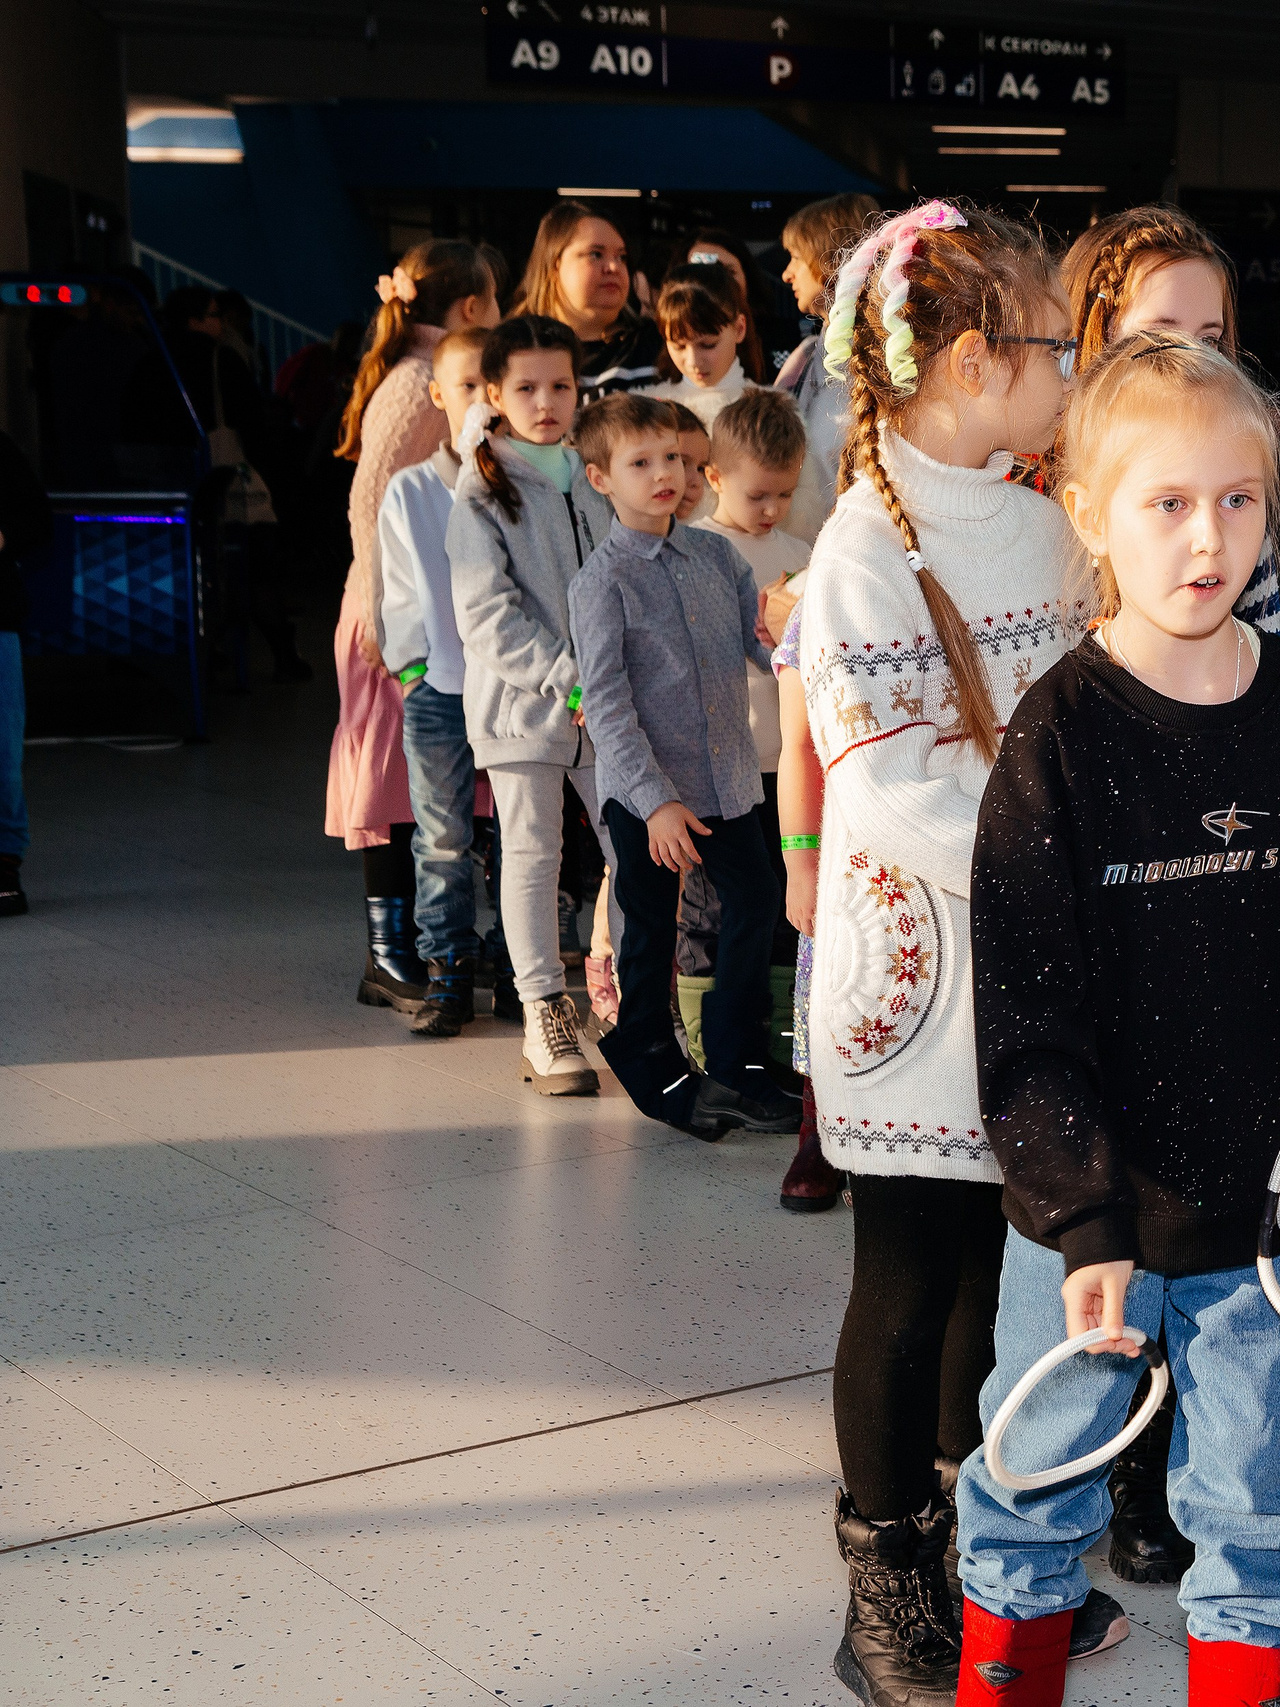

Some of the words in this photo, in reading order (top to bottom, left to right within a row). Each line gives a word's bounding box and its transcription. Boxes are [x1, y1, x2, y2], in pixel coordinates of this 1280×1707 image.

[597, 5, 650, 27] ЭТАЖ
[511, 38, 560, 71] A9
[589, 43, 653, 77] A10
[1000, 35, 1086, 58] СЕКТОРАМ
[769, 54, 793, 85] P
[998, 72, 1041, 101] A4
[1071, 77, 1111, 105] A5
